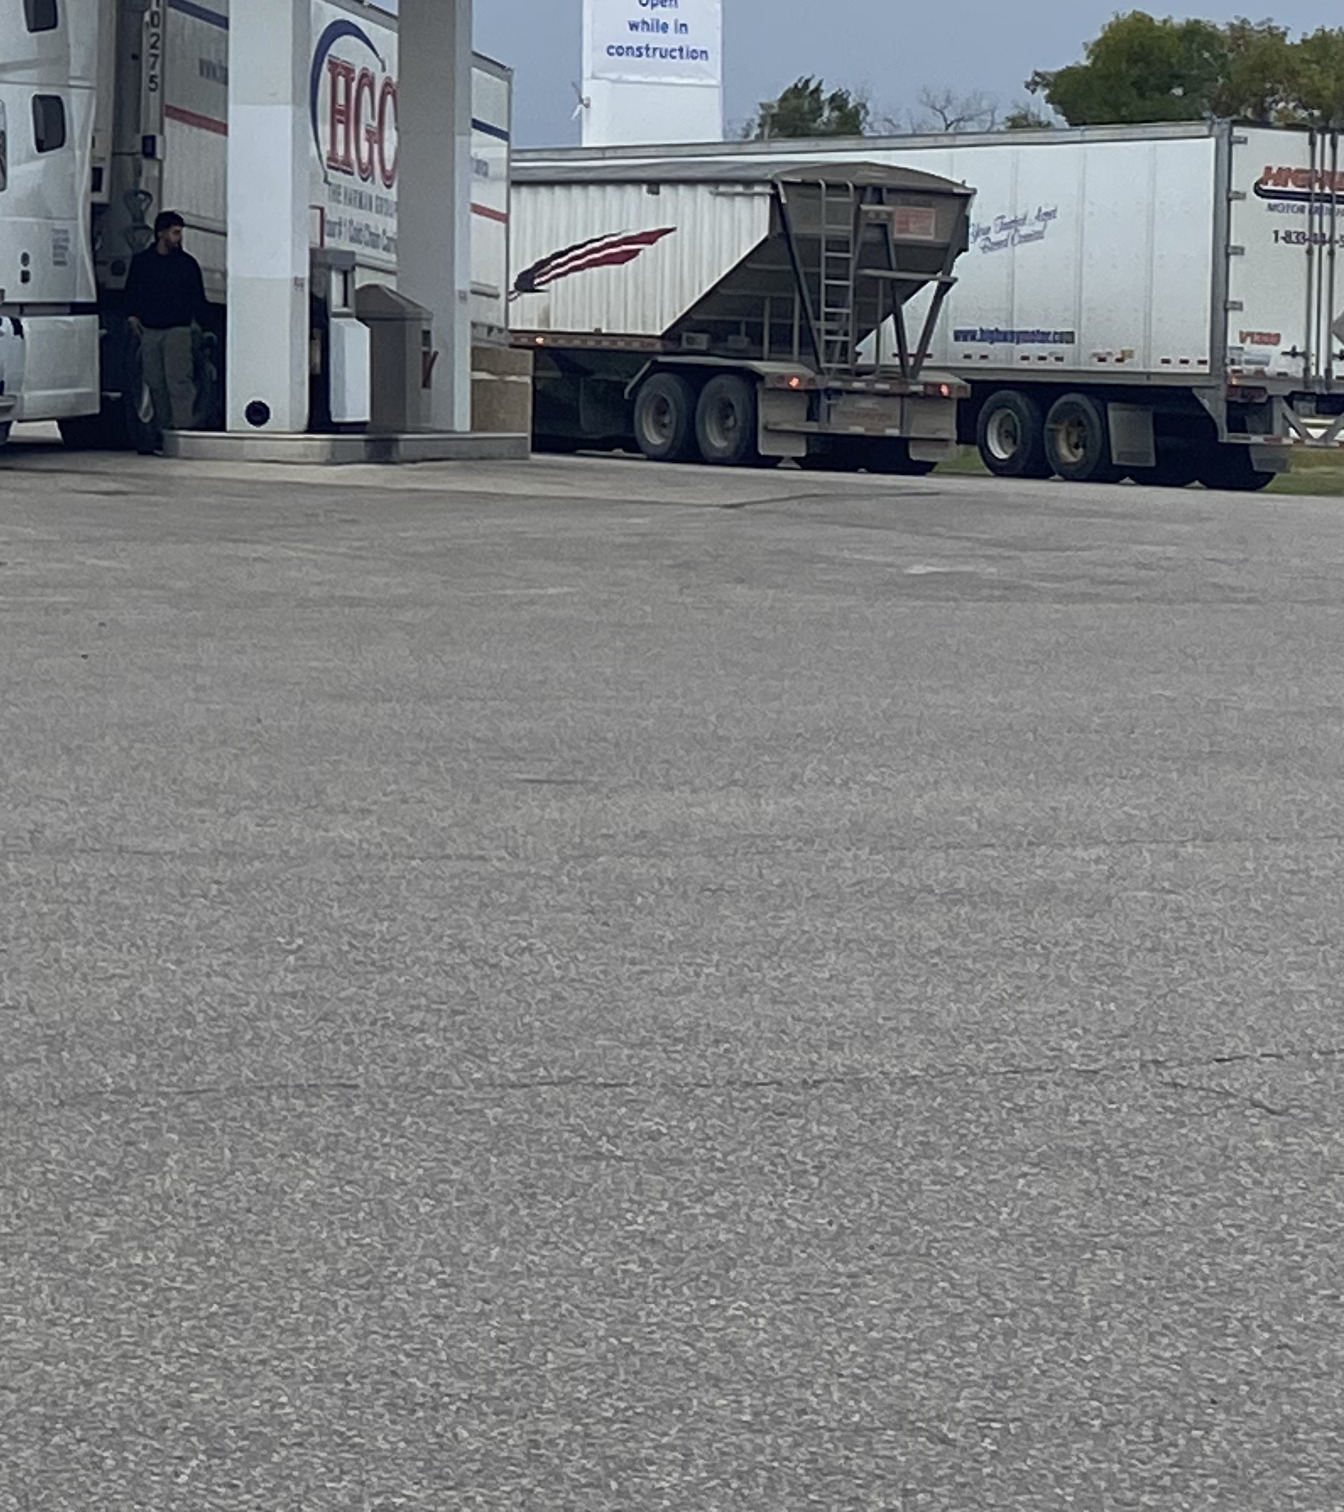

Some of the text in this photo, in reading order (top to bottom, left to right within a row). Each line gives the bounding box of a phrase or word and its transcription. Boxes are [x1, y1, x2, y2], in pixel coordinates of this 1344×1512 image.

[627, 17, 689, 35] while in
[606, 43, 710, 62] construction
